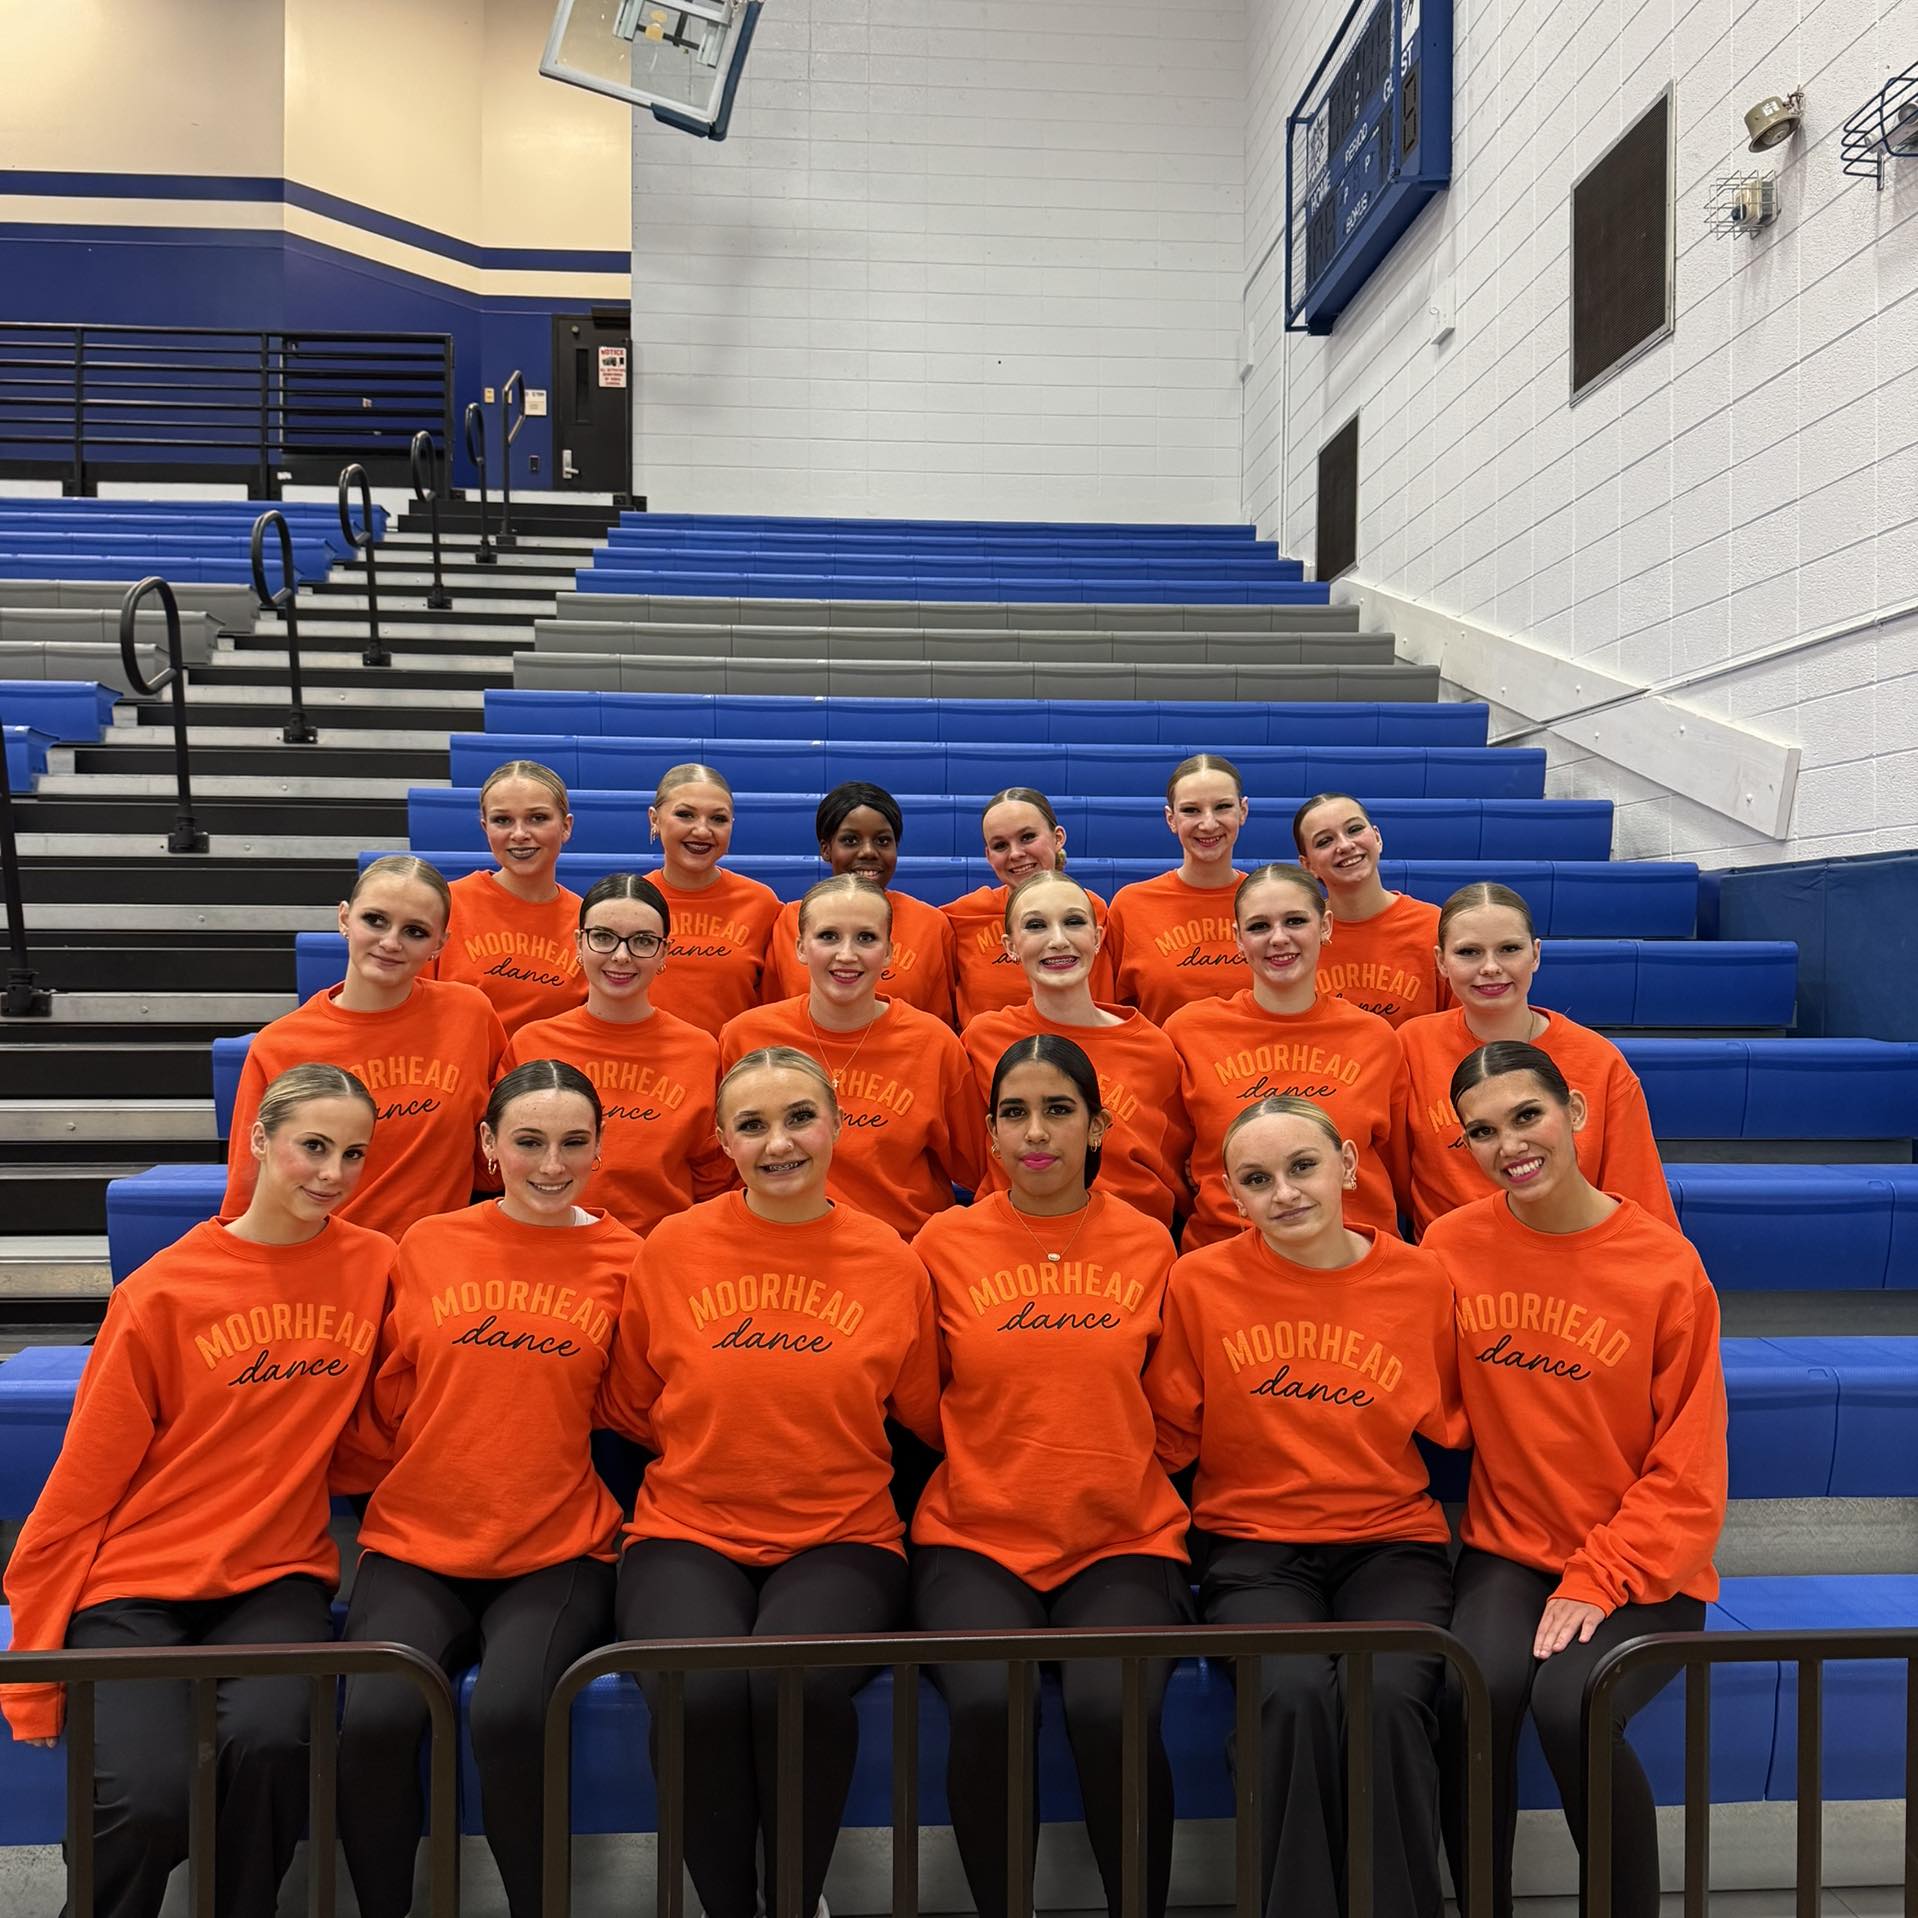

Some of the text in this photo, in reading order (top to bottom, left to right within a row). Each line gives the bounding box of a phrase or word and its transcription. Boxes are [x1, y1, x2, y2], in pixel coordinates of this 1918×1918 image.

[1311, 169, 1331, 216] HOME
[668, 939, 732, 957] ance
[670, 912, 750, 948] ORHEAD
[1154, 917, 1235, 958] MOORH
[483, 957, 565, 987] dance
[1176, 946, 1248, 967] danc
[1315, 963, 1421, 1001] OORHEAD
[349, 1056, 460, 1094] ORHEAD
[585, 1060, 686, 1111] ORHEAD
[1214, 1044, 1361, 1086] MOORHEAD
[833, 1068, 915, 1117] RHEAD
[1236, 1076, 1337, 1099] dance
[377, 1098, 441, 1120] nce
[602, 1104, 662, 1121] nce
[843, 1113, 889, 1128] nce
[688, 1272, 865, 1337] MOORHEAD
[968, 1261, 1145, 1316] MOORHEAD
[431, 1279, 609, 1345] MOORHEAD
[997, 1301, 1121, 1332] dance
[1455, 1291, 1631, 1368] MOORHEAD
[194, 1303, 377, 1370] MOORHEAD
[452, 1315, 581, 1357] dance
[712, 1317, 833, 1353] dance
[228, 1349, 349, 1387] dance
[1222, 1320, 1403, 1393] MOORHEAD
[1475, 1334, 1591, 1381] dance
[1250, 1364, 1374, 1408] dance
